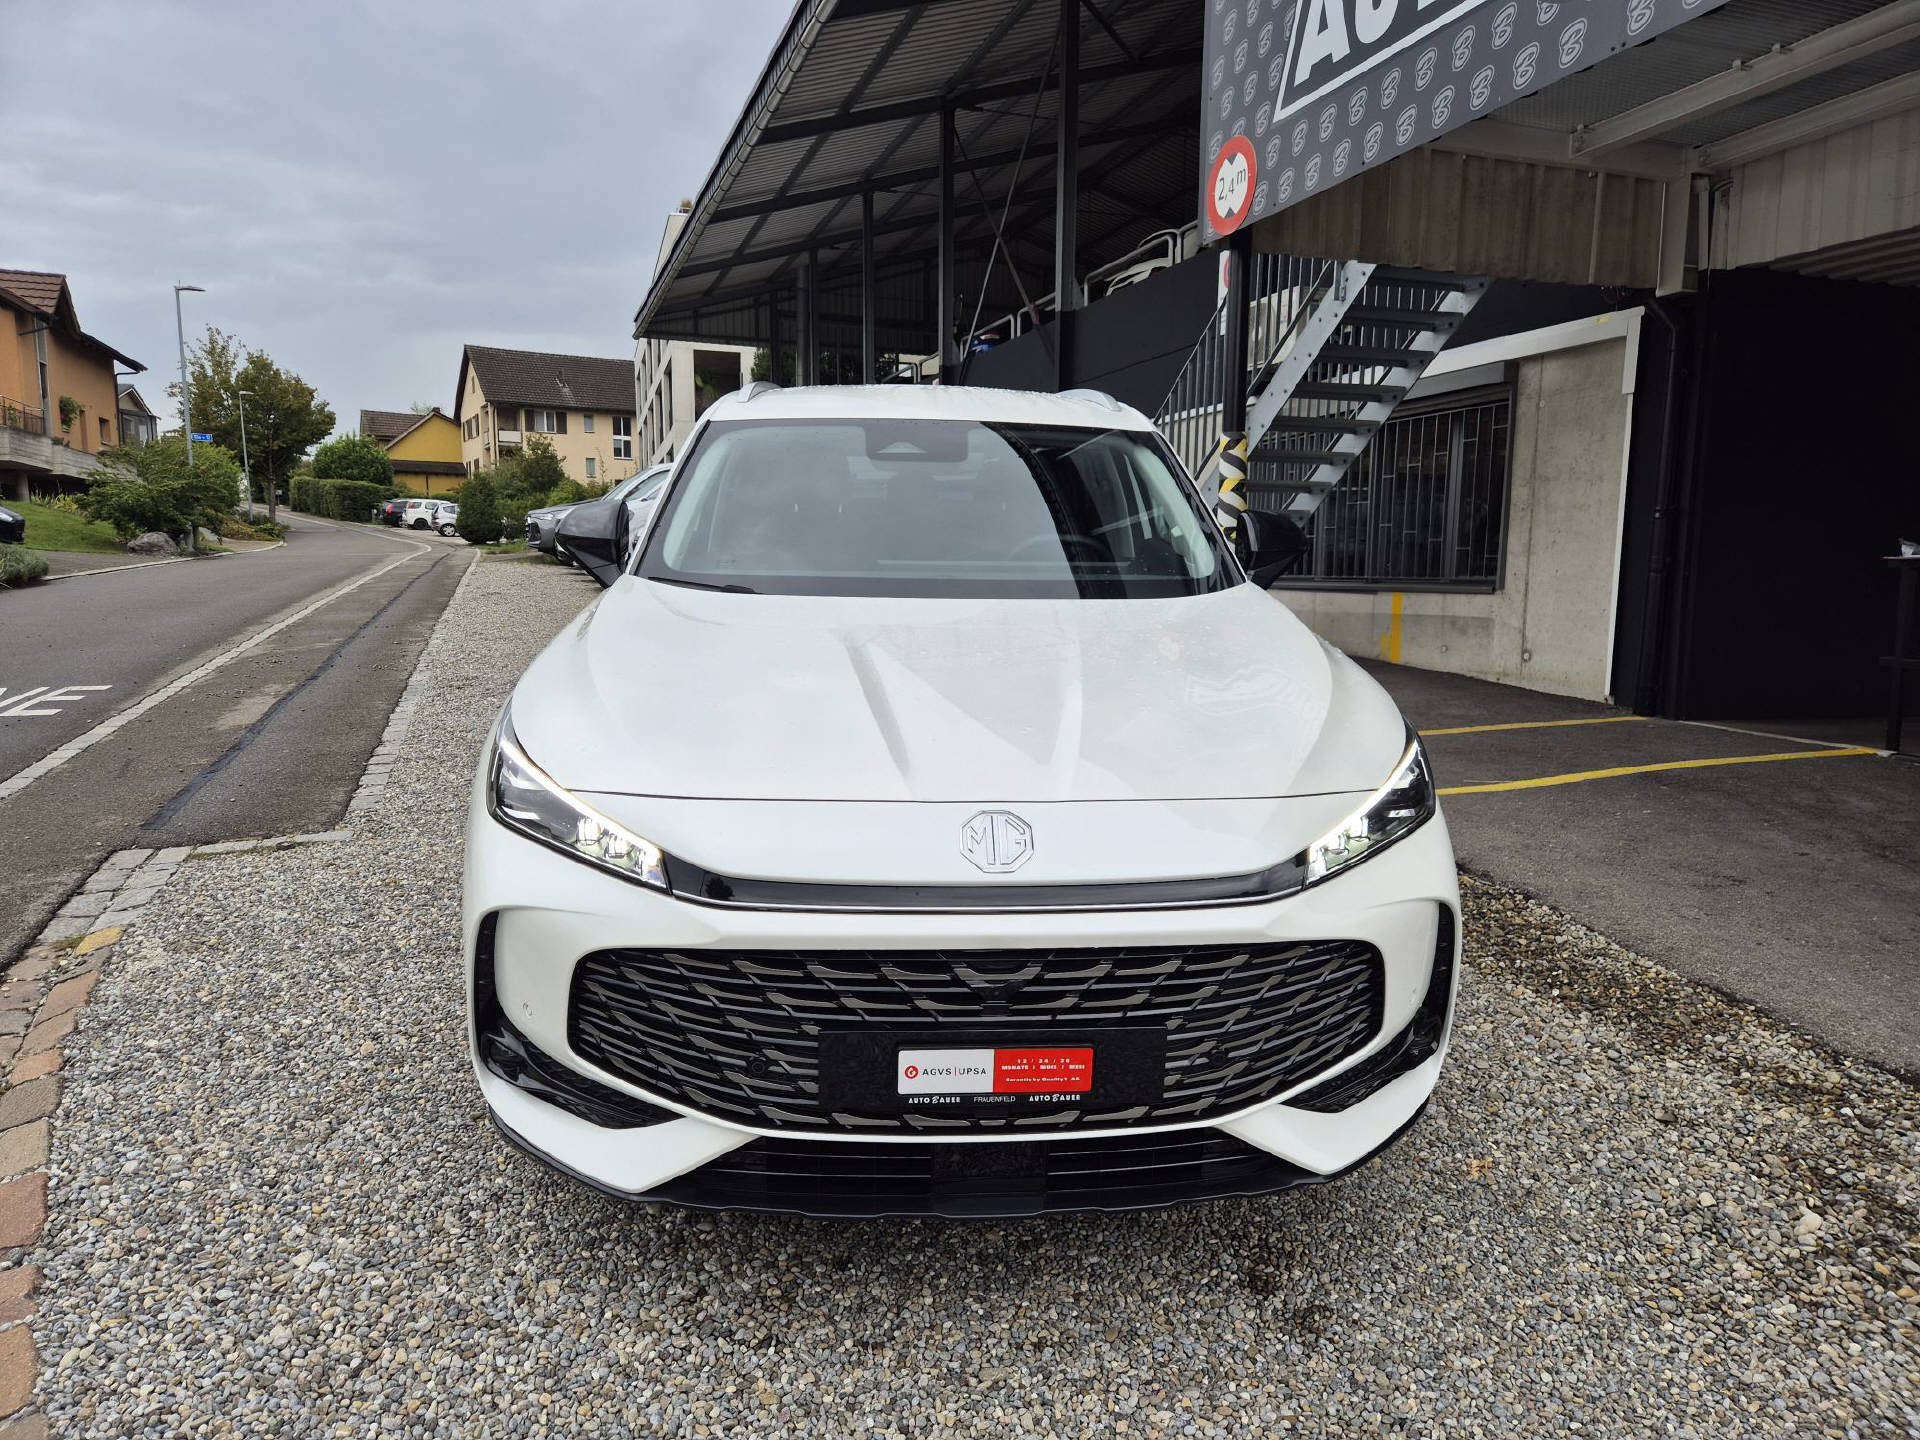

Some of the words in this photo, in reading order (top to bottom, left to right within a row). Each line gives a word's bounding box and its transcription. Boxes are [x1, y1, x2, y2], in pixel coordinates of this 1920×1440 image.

[966, 814, 1028, 867] MG
[922, 1068, 952, 1076] AGVS
[958, 1067, 987, 1075] UPSA
[908, 1096, 930, 1104] AUTO
[1029, 1094, 1051, 1102] AUTO
